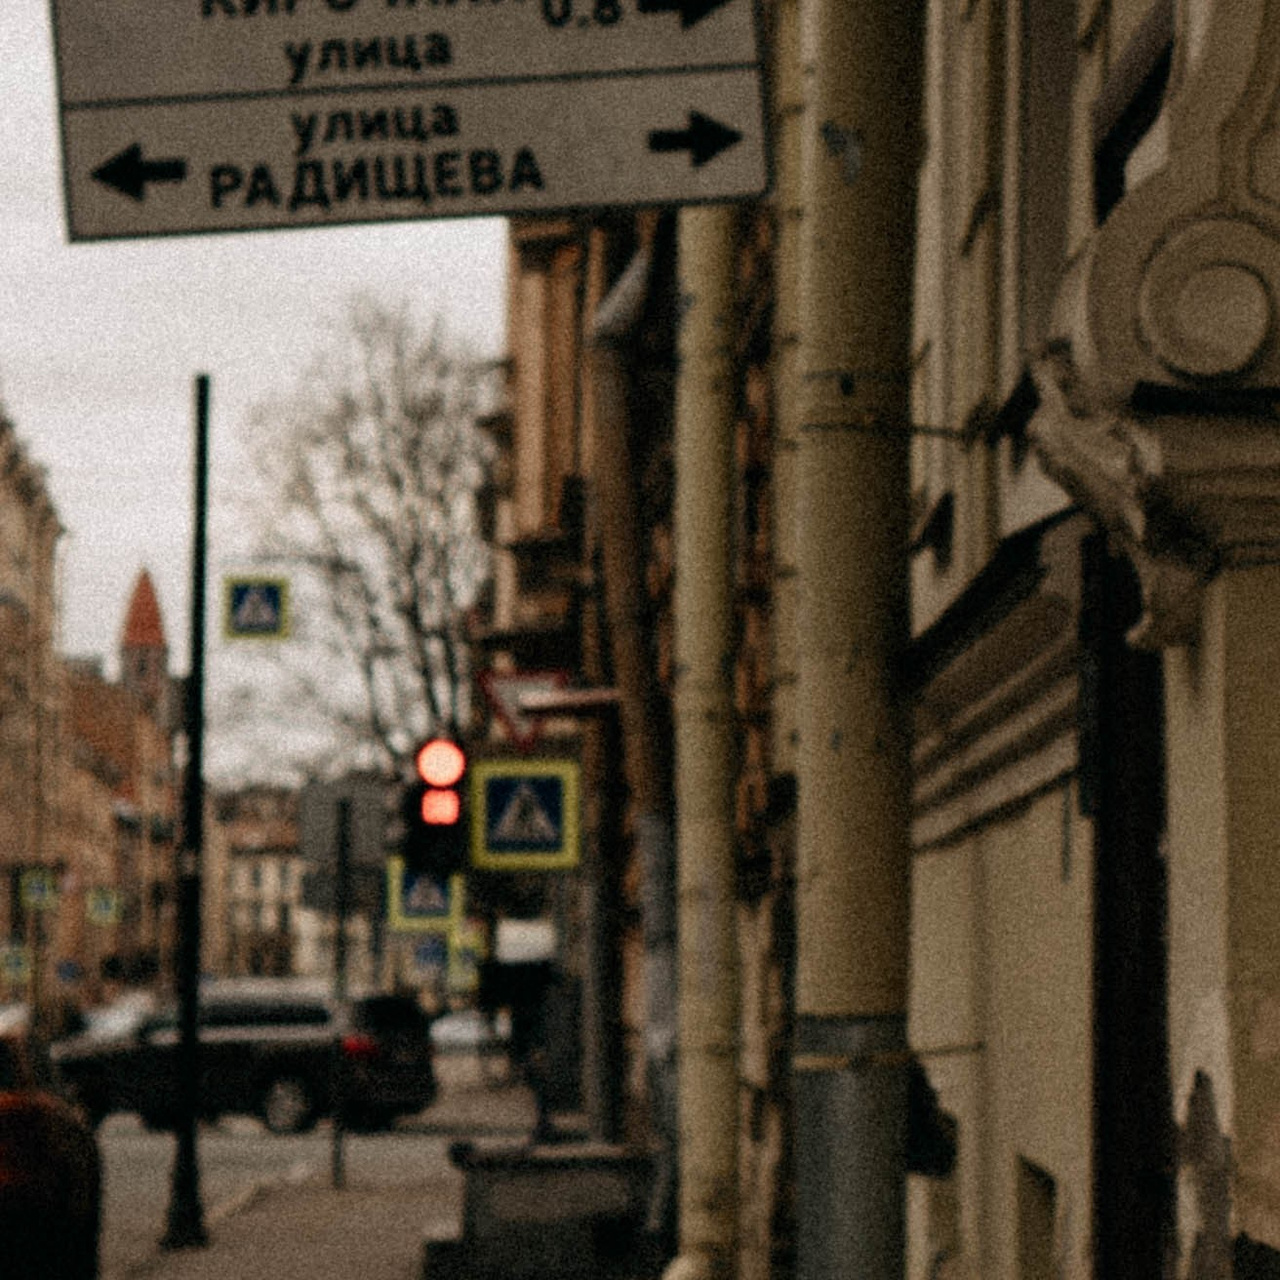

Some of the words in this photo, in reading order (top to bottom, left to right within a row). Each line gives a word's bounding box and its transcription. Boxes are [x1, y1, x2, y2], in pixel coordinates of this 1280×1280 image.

[286, 32, 452, 84] улица
[292, 101, 458, 154] улица
[210, 148, 544, 211] РАДИЩЕВА
